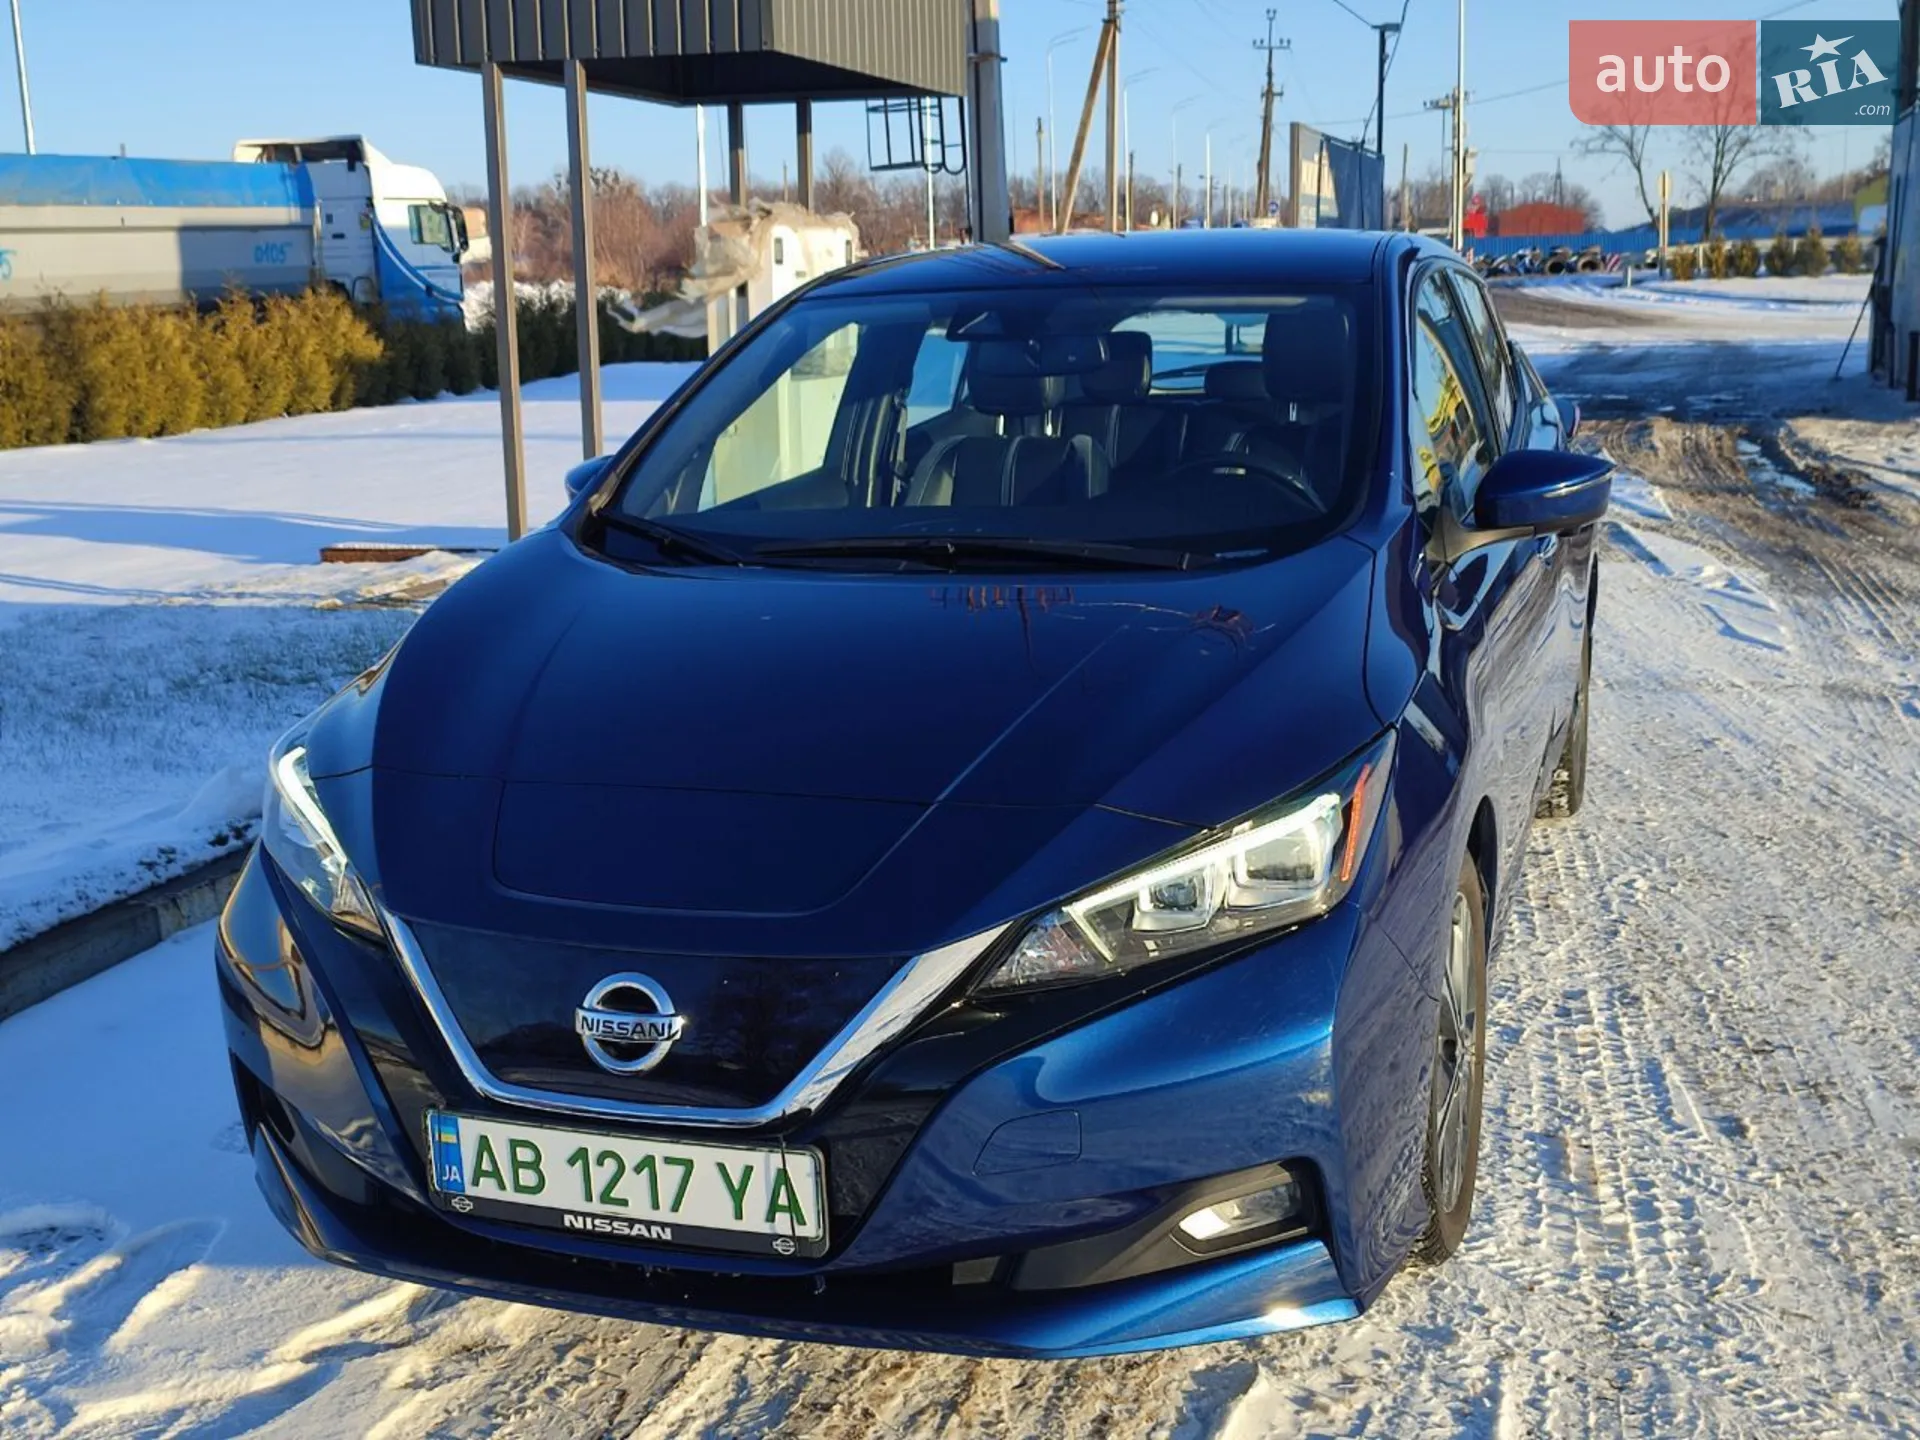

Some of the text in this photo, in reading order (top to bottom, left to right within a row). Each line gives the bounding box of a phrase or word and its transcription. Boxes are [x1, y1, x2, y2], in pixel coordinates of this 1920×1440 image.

[581, 1015, 666, 1038] NISSAN
[471, 1134, 807, 1227] AB 1217 YA
[563, 1213, 673, 1241] NISSAN
